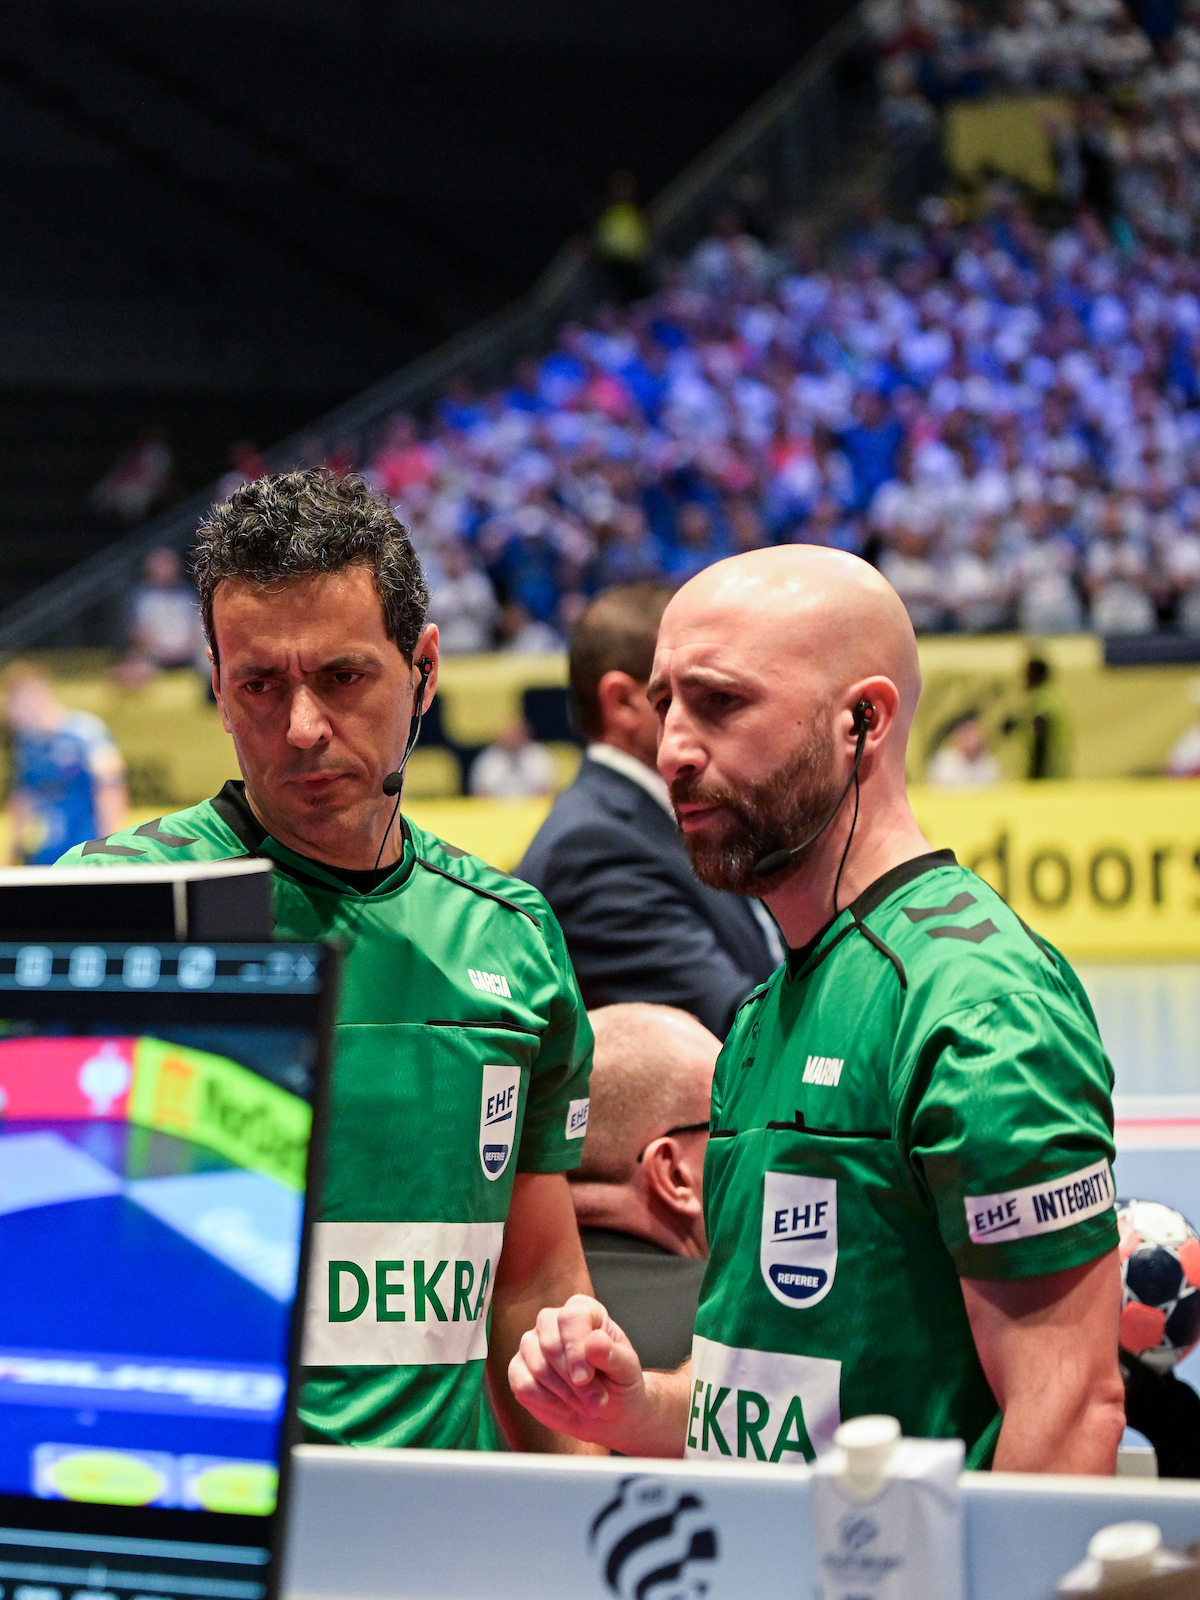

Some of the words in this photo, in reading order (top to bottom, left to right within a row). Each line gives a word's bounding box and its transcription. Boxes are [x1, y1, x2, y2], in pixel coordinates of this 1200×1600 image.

[968, 829, 1200, 911] door
[468, 968, 512, 999] GARCIA
[486, 1085, 515, 1119] EHF
[485, 1152, 505, 1161] REFEREE
[974, 1198, 1017, 1231] EHF
[1032, 1169, 1110, 1224] INTEGRITY
[774, 1201, 828, 1235] EHF
[328, 1258, 490, 1322] DEKRA
[777, 1272, 820, 1288] REFEREE
[687, 1379, 817, 1466] EKRA
